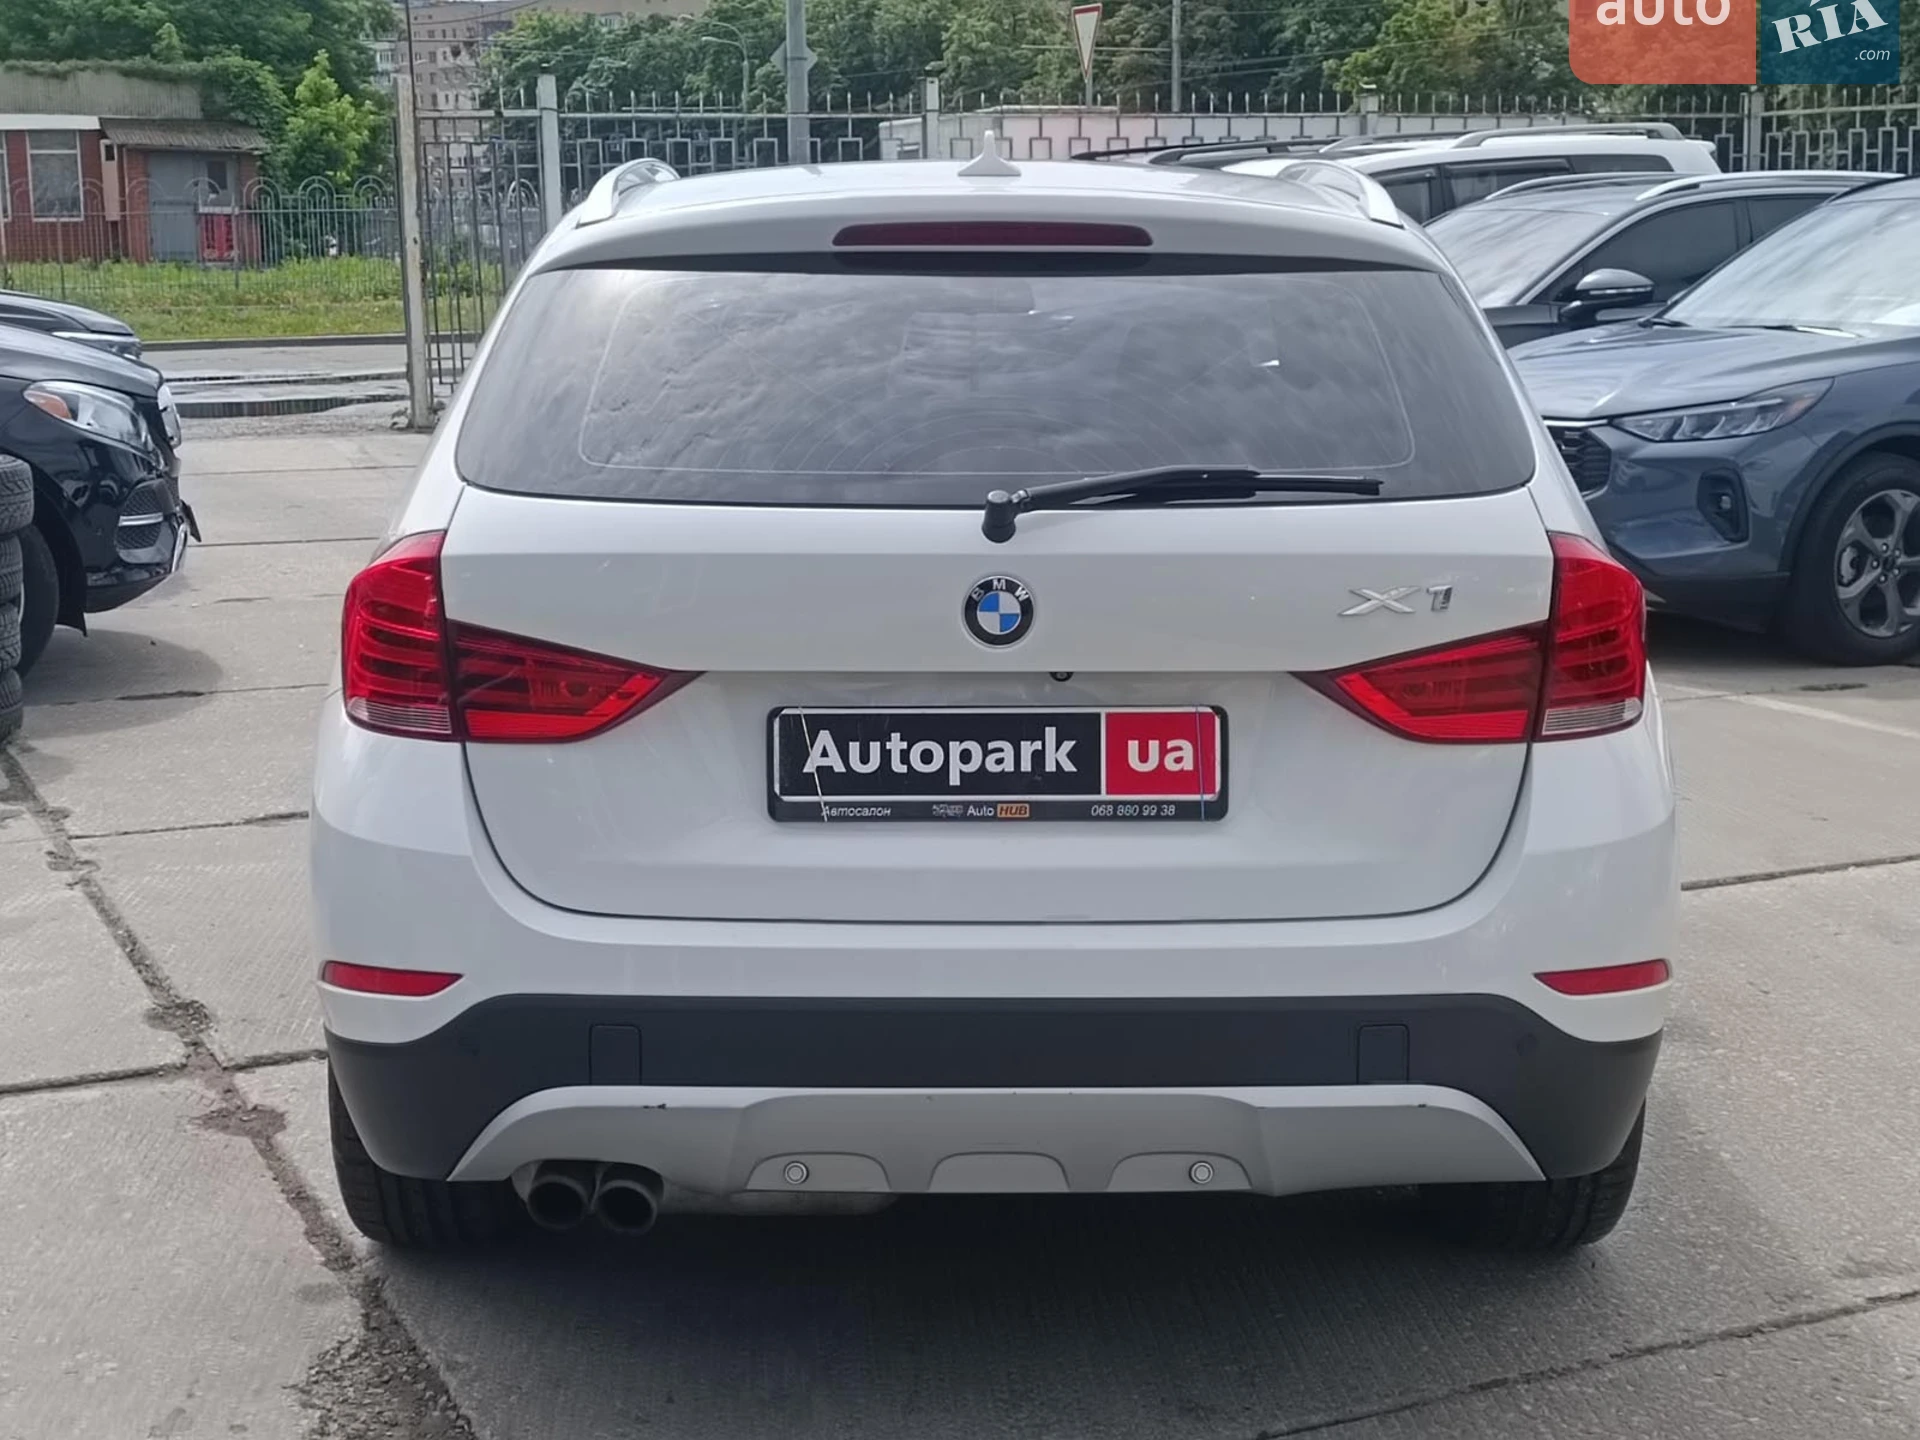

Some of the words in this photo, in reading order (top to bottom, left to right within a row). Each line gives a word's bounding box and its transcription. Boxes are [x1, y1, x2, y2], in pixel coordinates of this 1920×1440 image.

[971, 578, 1029, 602] BMW
[1337, 585, 1453, 617] X1
[802, 726, 1078, 786] Autopark
[1127, 738, 1195, 773] ua
[821, 805, 892, 818] Автосалон
[966, 805, 995, 817] Auto
[999, 804, 1029, 816] HUB
[1091, 804, 1114, 817] 068
[1116, 804, 1140, 817] 880
[1142, 804, 1158, 817] 99
[1160, 804, 1176, 817] 38
